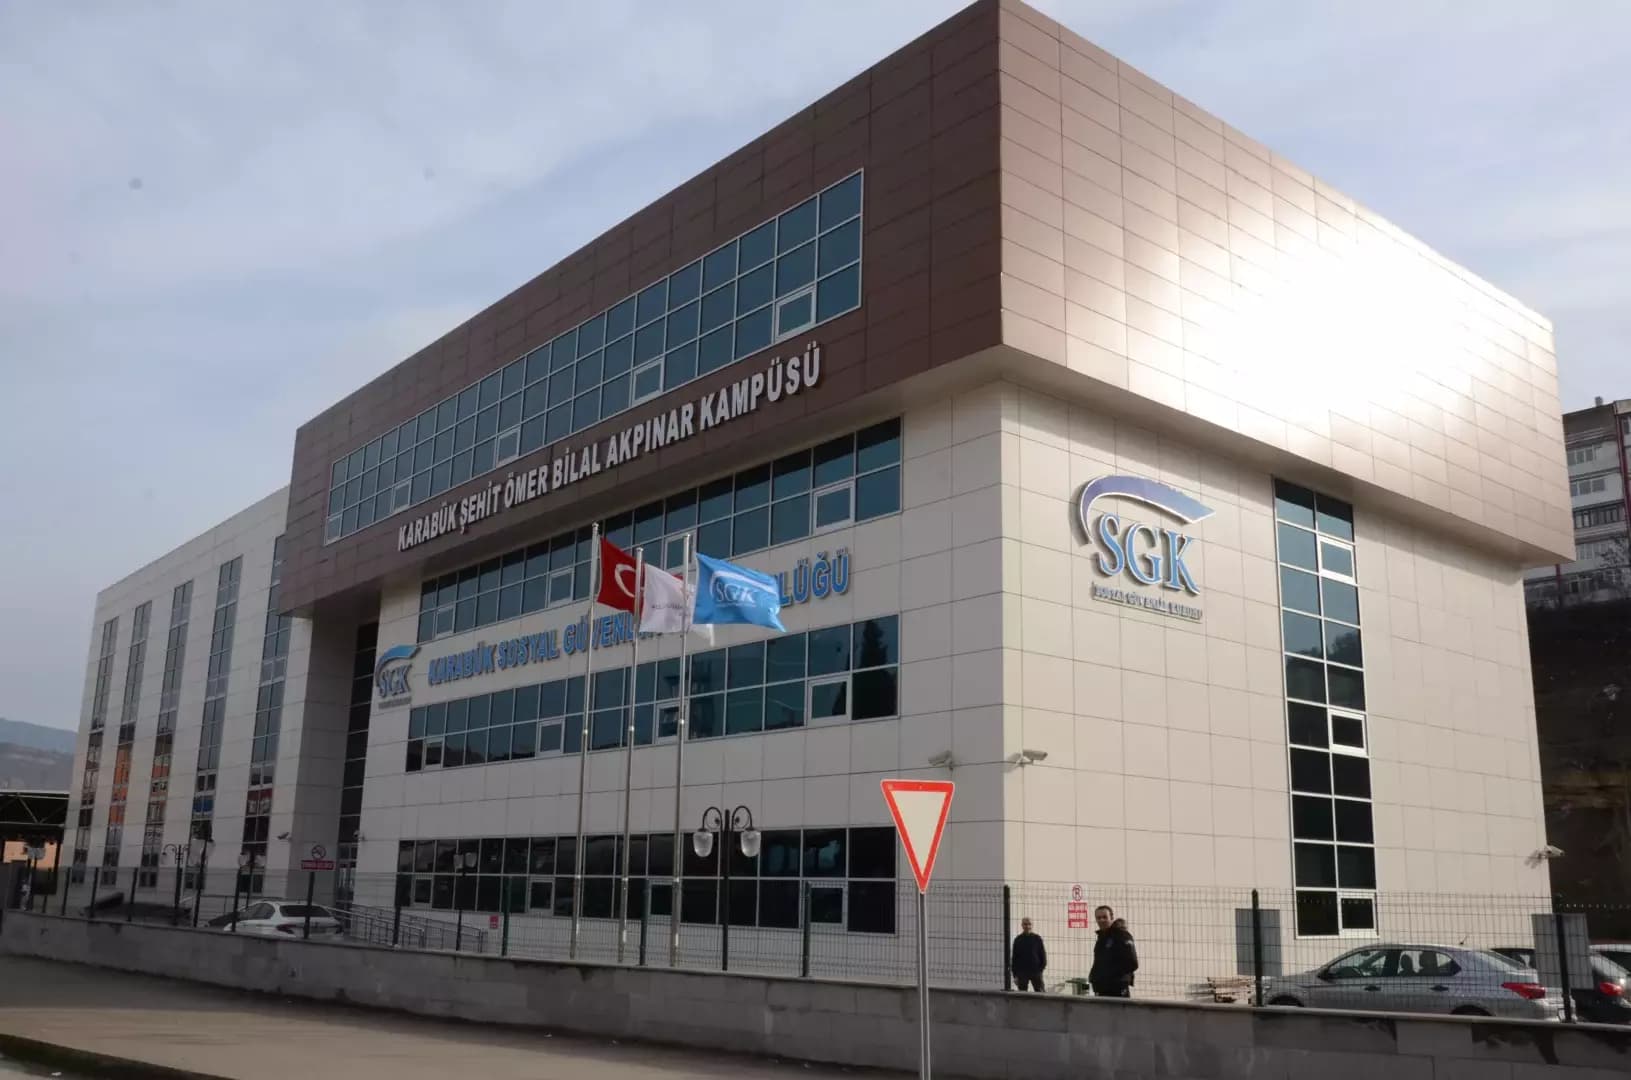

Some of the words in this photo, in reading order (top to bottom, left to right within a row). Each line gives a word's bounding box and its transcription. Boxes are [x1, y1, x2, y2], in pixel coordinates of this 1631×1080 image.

[398, 502, 457, 551] KARABÜK
[459, 481, 502, 534] ŞEHİT
[504, 465, 548, 508] ÖMER
[551, 443, 600, 490] BİLAL
[605, 402, 694, 468] AKPINAR
[700, 341, 820, 430] KAMPÜSÜ
[1098, 513, 1201, 596] SGK
[497, 630, 561, 671] SOSYAL
